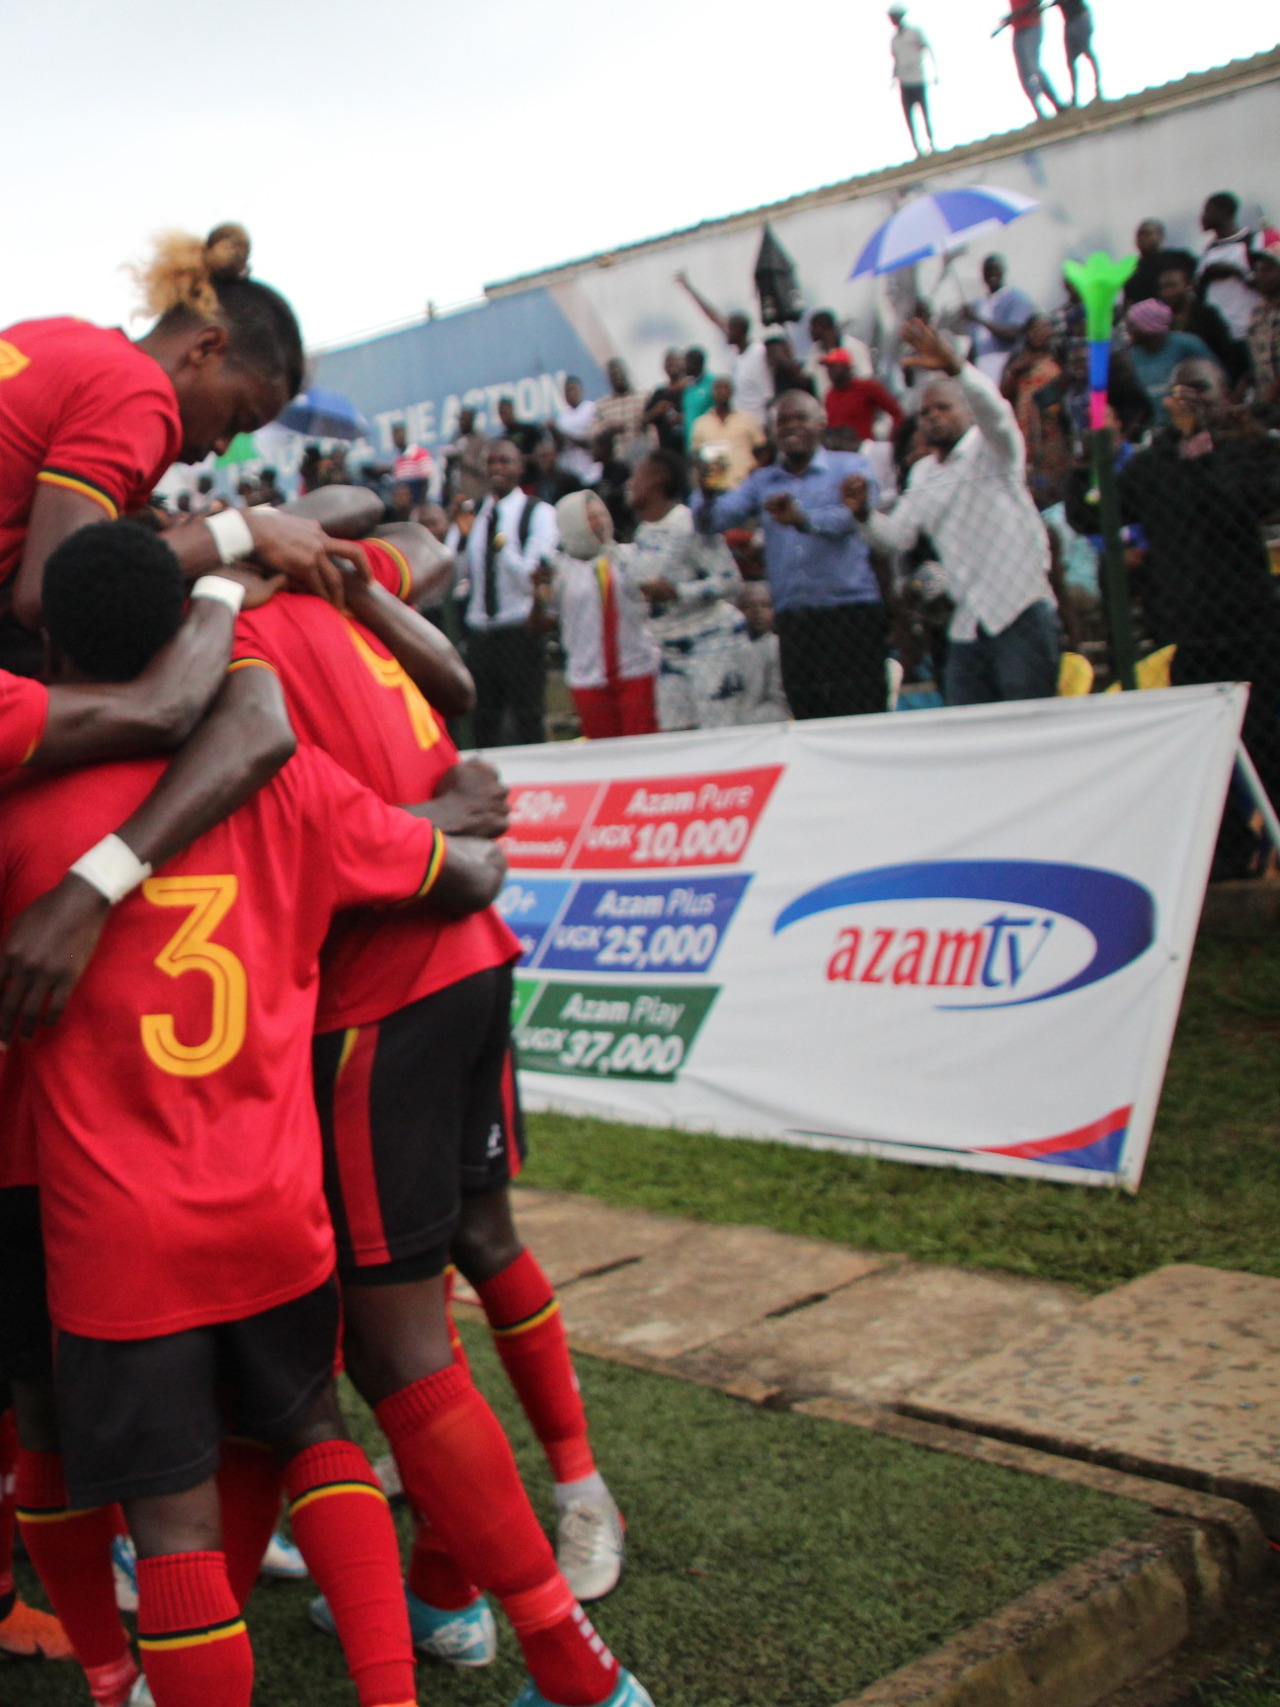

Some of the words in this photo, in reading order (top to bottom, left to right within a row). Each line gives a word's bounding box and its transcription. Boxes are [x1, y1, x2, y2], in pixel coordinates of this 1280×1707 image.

[625, 789, 695, 817] Azam
[697, 783, 754, 812] Pure
[586, 824, 634, 849] UGX
[631, 816, 749, 864] 10,000
[594, 889, 665, 918] Azam
[668, 887, 718, 918] Plus
[553, 924, 604, 949] UGX
[595, 921, 719, 970] 25,000
[140, 874, 247, 1077] 3
[560, 992, 631, 1023] Azam
[632, 995, 685, 1031] Play
[560, 1029, 685, 1076] 37,000
